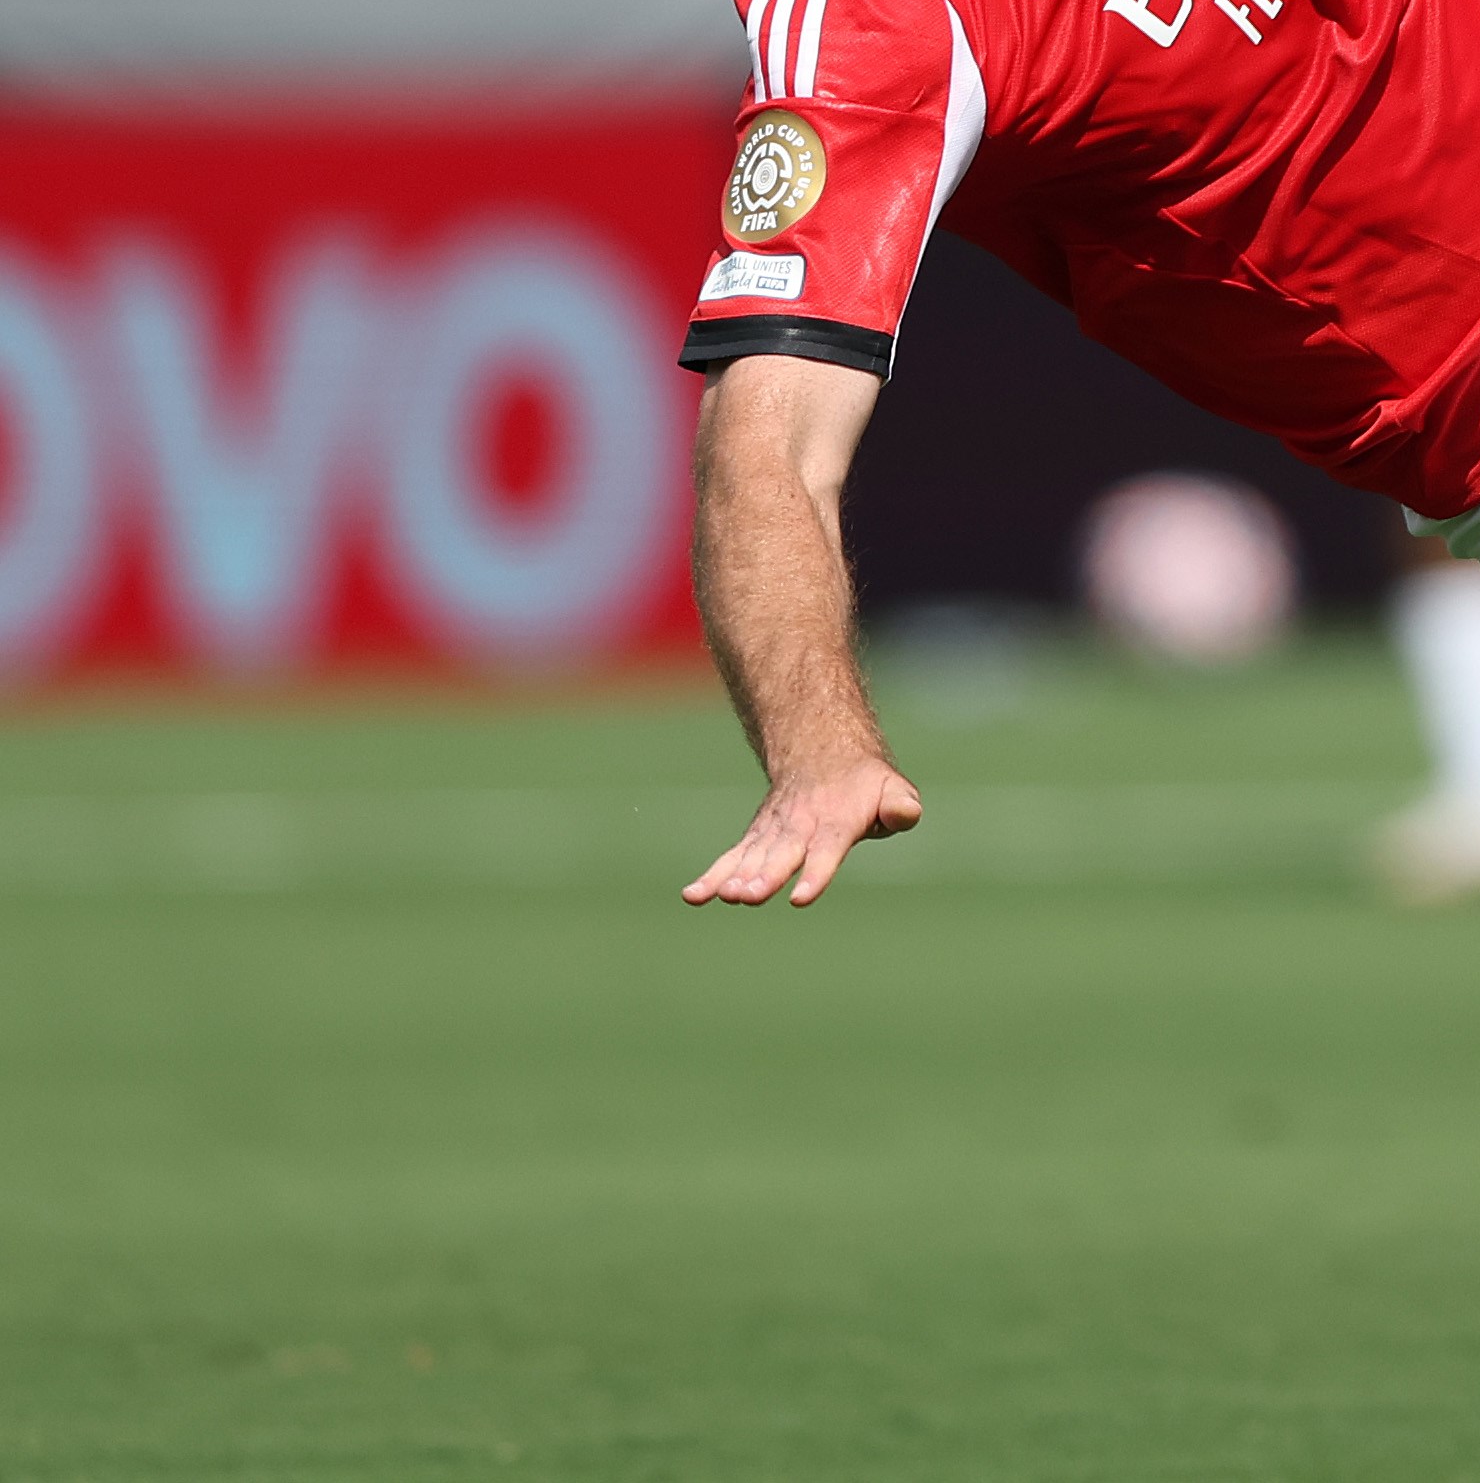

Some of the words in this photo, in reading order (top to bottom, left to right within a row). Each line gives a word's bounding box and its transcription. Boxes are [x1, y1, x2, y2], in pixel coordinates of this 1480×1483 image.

[738, 124, 774, 167] WORLD
[778, 124, 805, 147] CUP
[799, 151, 813, 172] 25
[730, 174, 743, 215] CLUB
[783, 177, 811, 208] USA
[740, 211, 777, 232] FIFA
[752, 260, 792, 274] UNITES
